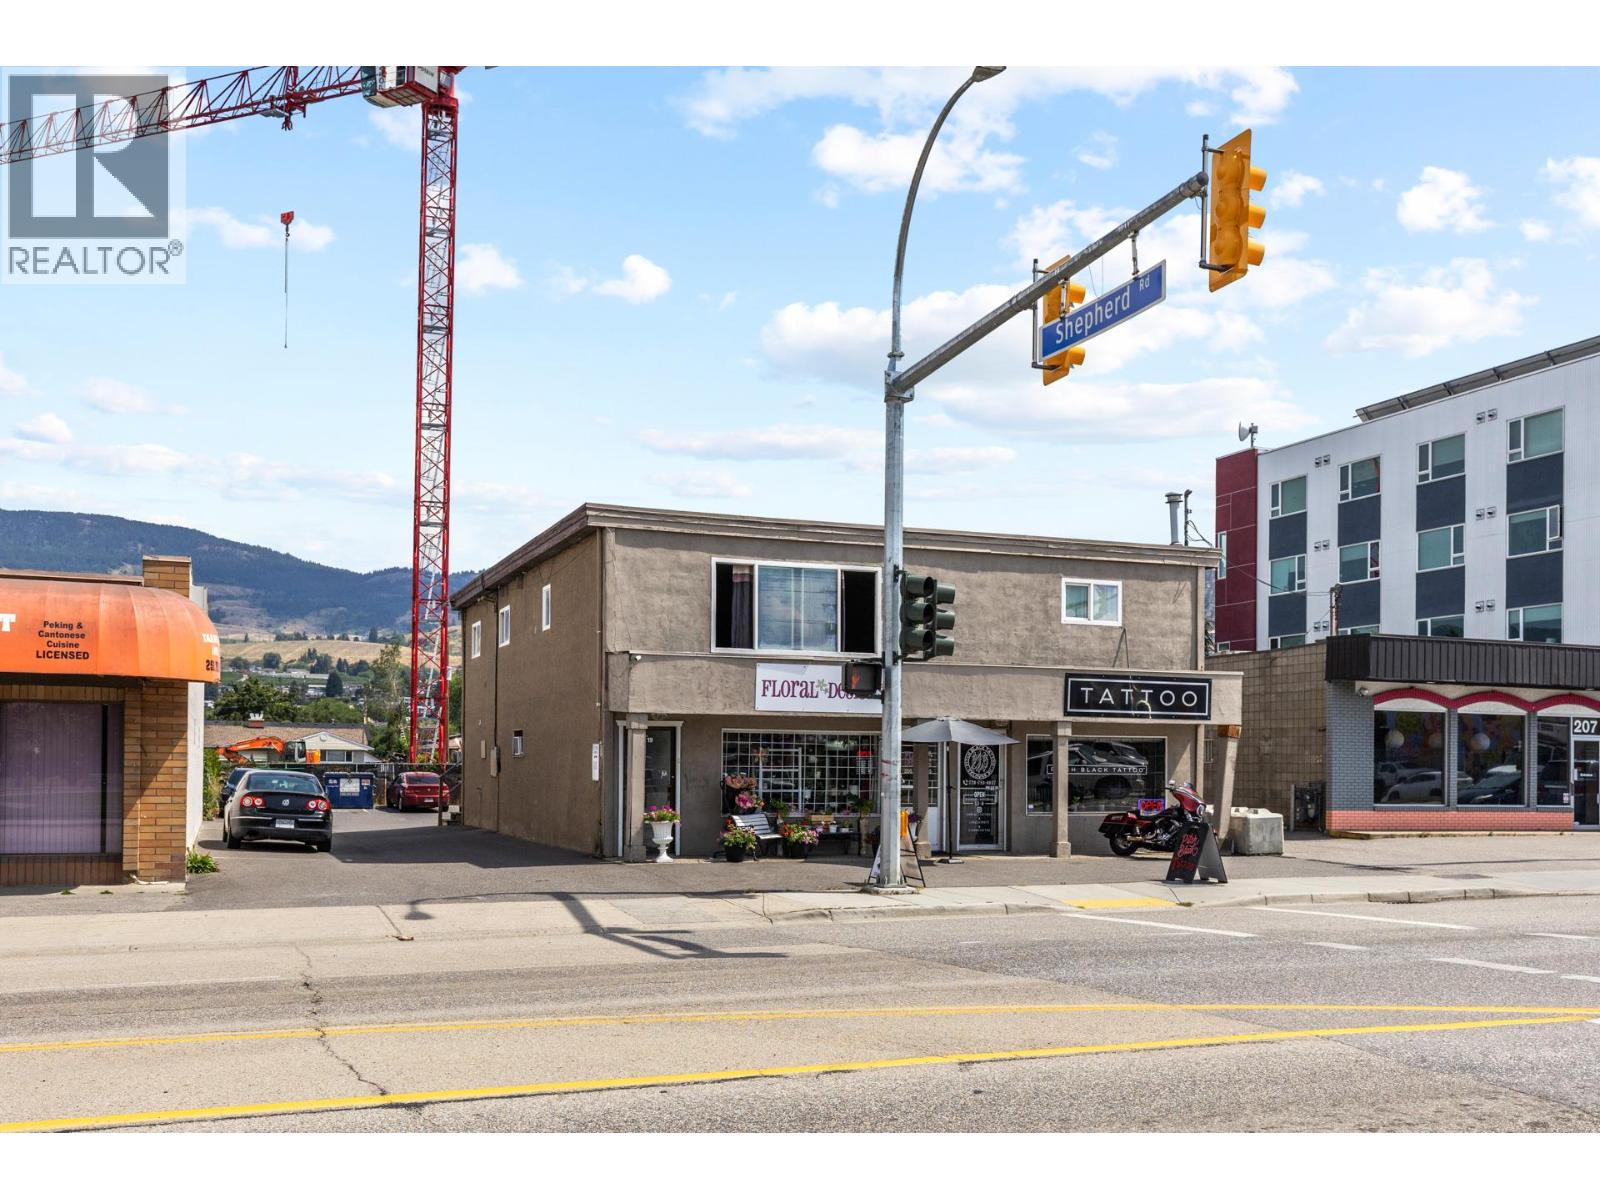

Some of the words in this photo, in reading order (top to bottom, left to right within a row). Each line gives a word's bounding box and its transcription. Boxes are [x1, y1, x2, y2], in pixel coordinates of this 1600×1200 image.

[1056, 286, 1130, 344] Shepherd
[1140, 275, 1150, 291] Rd
[43, 621, 73, 630] Peking
[38, 631, 86, 639] Cantonese
[36, 650, 90, 660] LICENSED
[1080, 687, 1198, 707] TATTOO
[1573, 720, 1598, 734] 207
